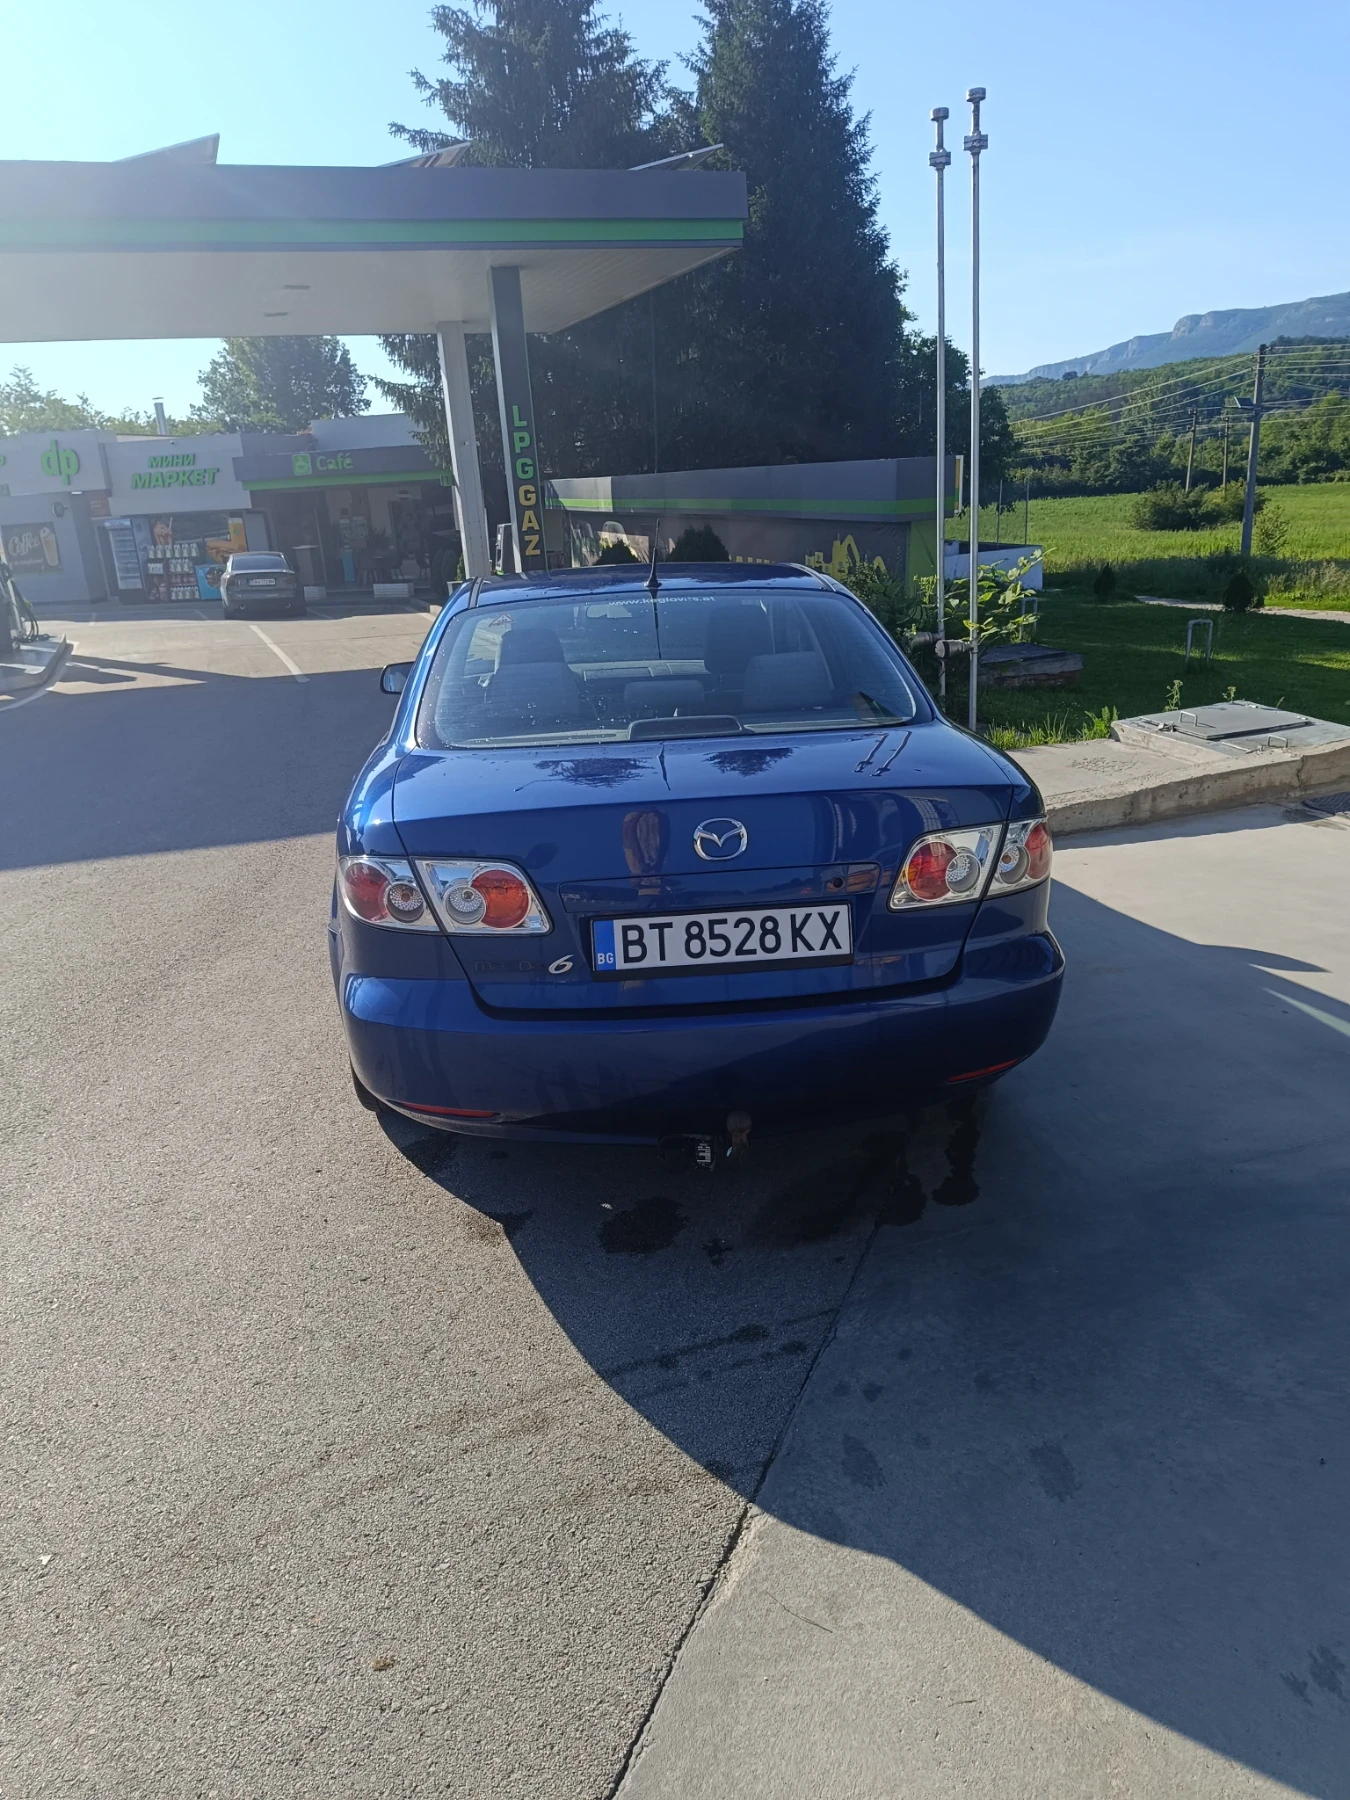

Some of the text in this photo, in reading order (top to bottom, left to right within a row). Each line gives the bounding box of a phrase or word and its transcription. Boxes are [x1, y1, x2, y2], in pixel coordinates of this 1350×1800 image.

[148, 453, 196, 469] МИНИ
[316, 452, 354, 471] Café
[131, 468, 219, 489] МАРКЕТ
[512, 405, 541, 556] LPG GAZ
[621, 911, 843, 964] BT 8528 KX
[548, 954, 575, 975] 6
[597, 952, 614, 965] BG
